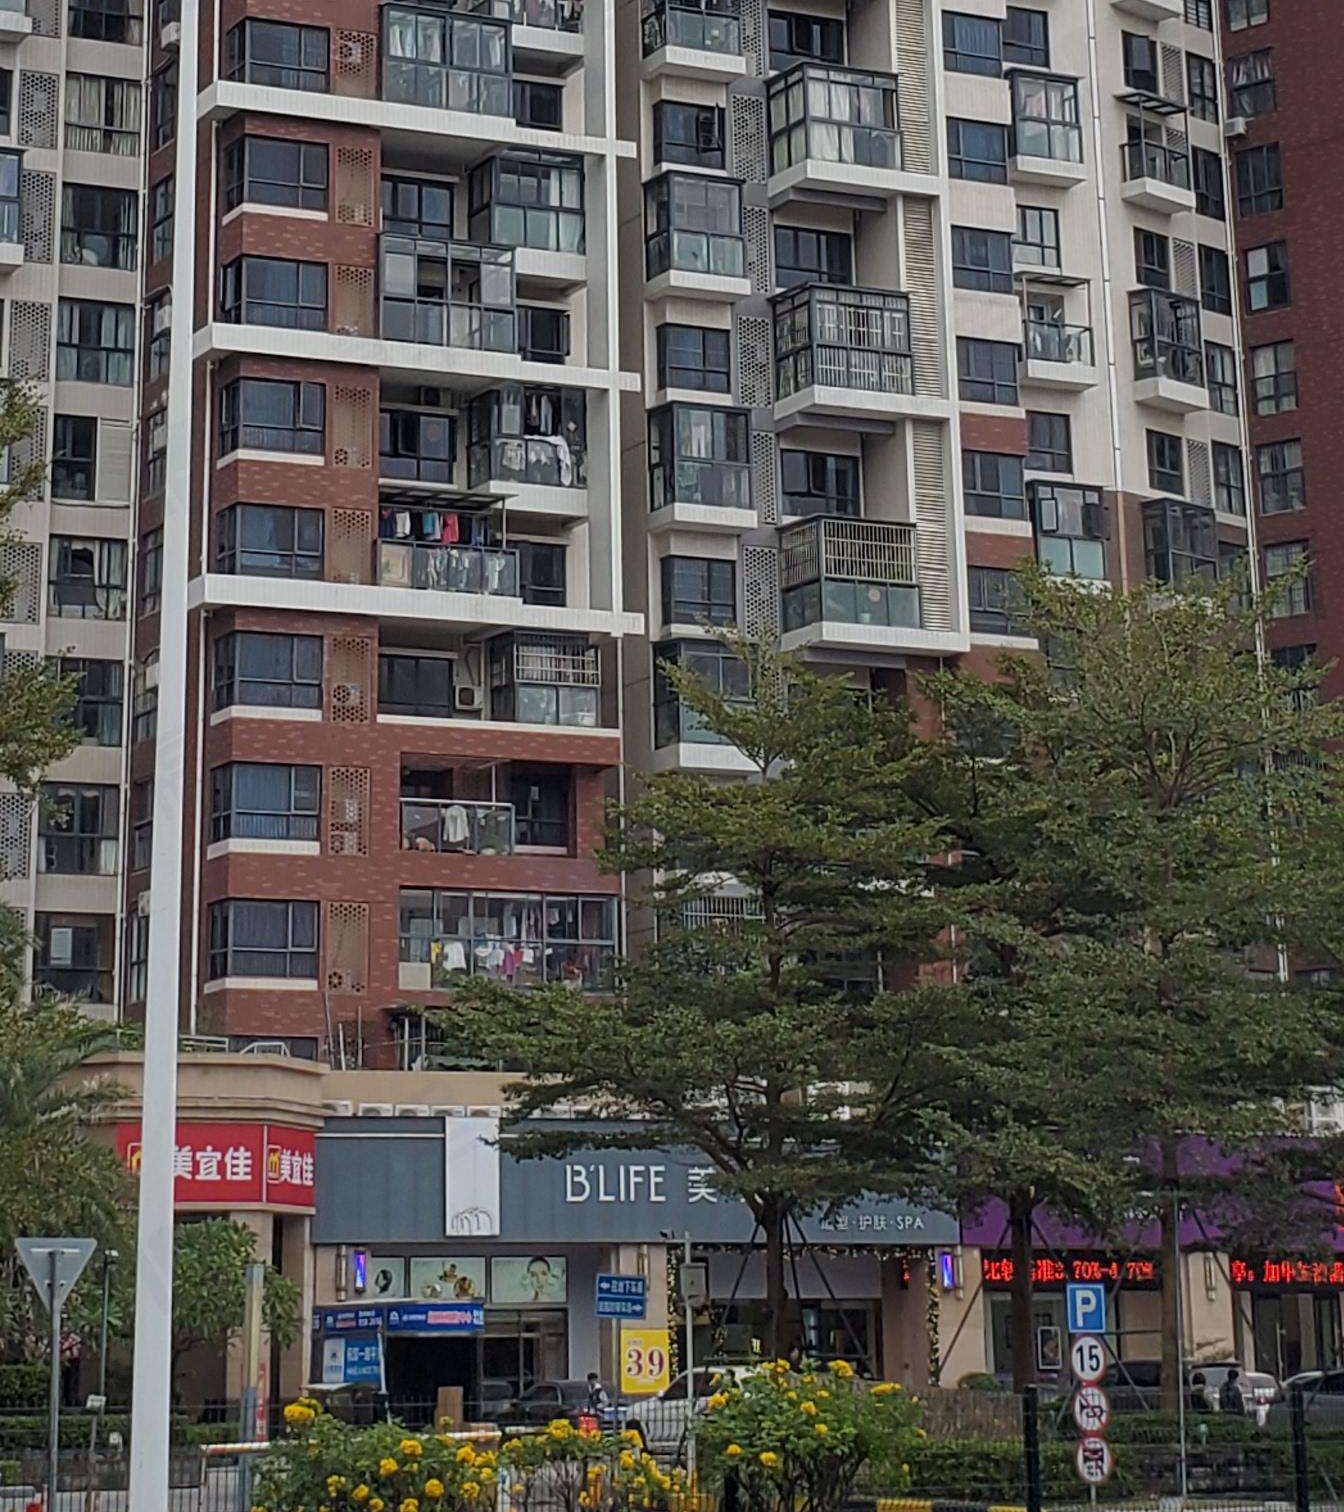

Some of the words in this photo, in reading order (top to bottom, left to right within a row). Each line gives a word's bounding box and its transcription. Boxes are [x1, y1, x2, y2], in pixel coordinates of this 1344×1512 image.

[174, 1145, 252, 1180] 美宜佳
[281, 1149, 314, 1186] 美宜佳
[1076, 1289, 1096, 1328] P
[626, 1348, 665, 1377] 39
[1076, 1344, 1100, 1373] 15
